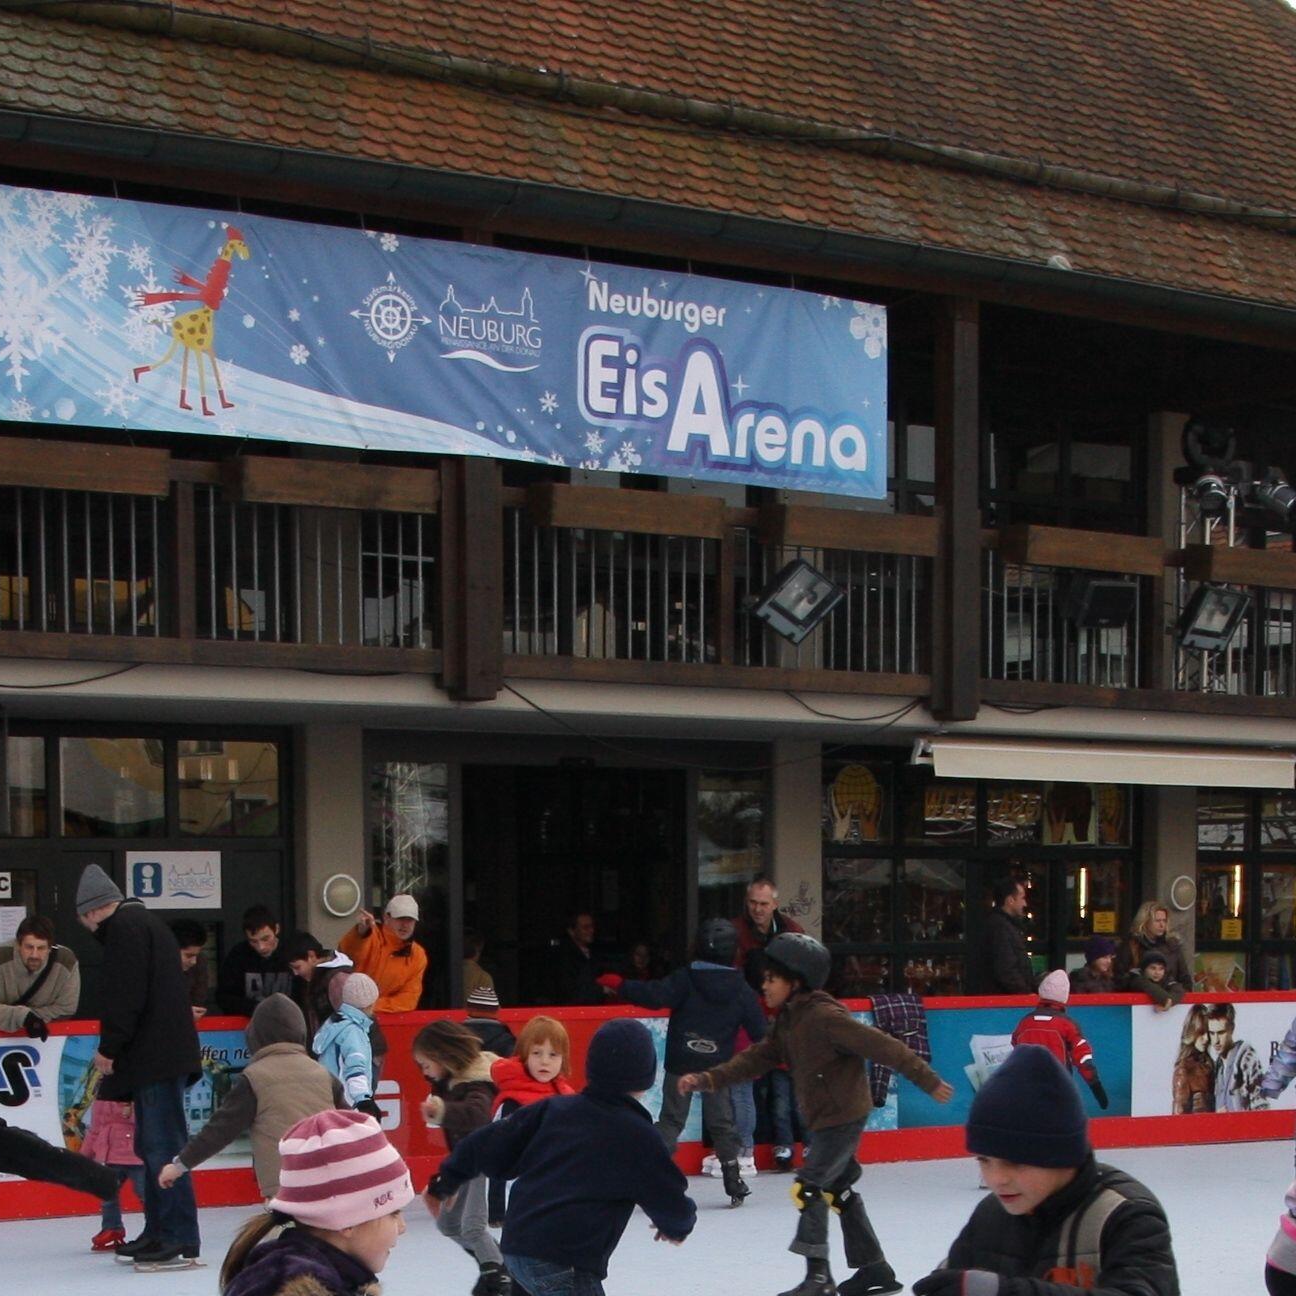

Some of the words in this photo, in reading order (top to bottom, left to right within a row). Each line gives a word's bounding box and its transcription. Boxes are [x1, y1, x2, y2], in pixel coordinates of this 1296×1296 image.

[588, 280, 727, 333] Neuburger
[439, 314, 542, 349] NEUBURG
[168, 876, 217, 888] NEUBURG
[200, 1045, 228, 1060] ffen
[233, 1046, 252, 1060] ne
